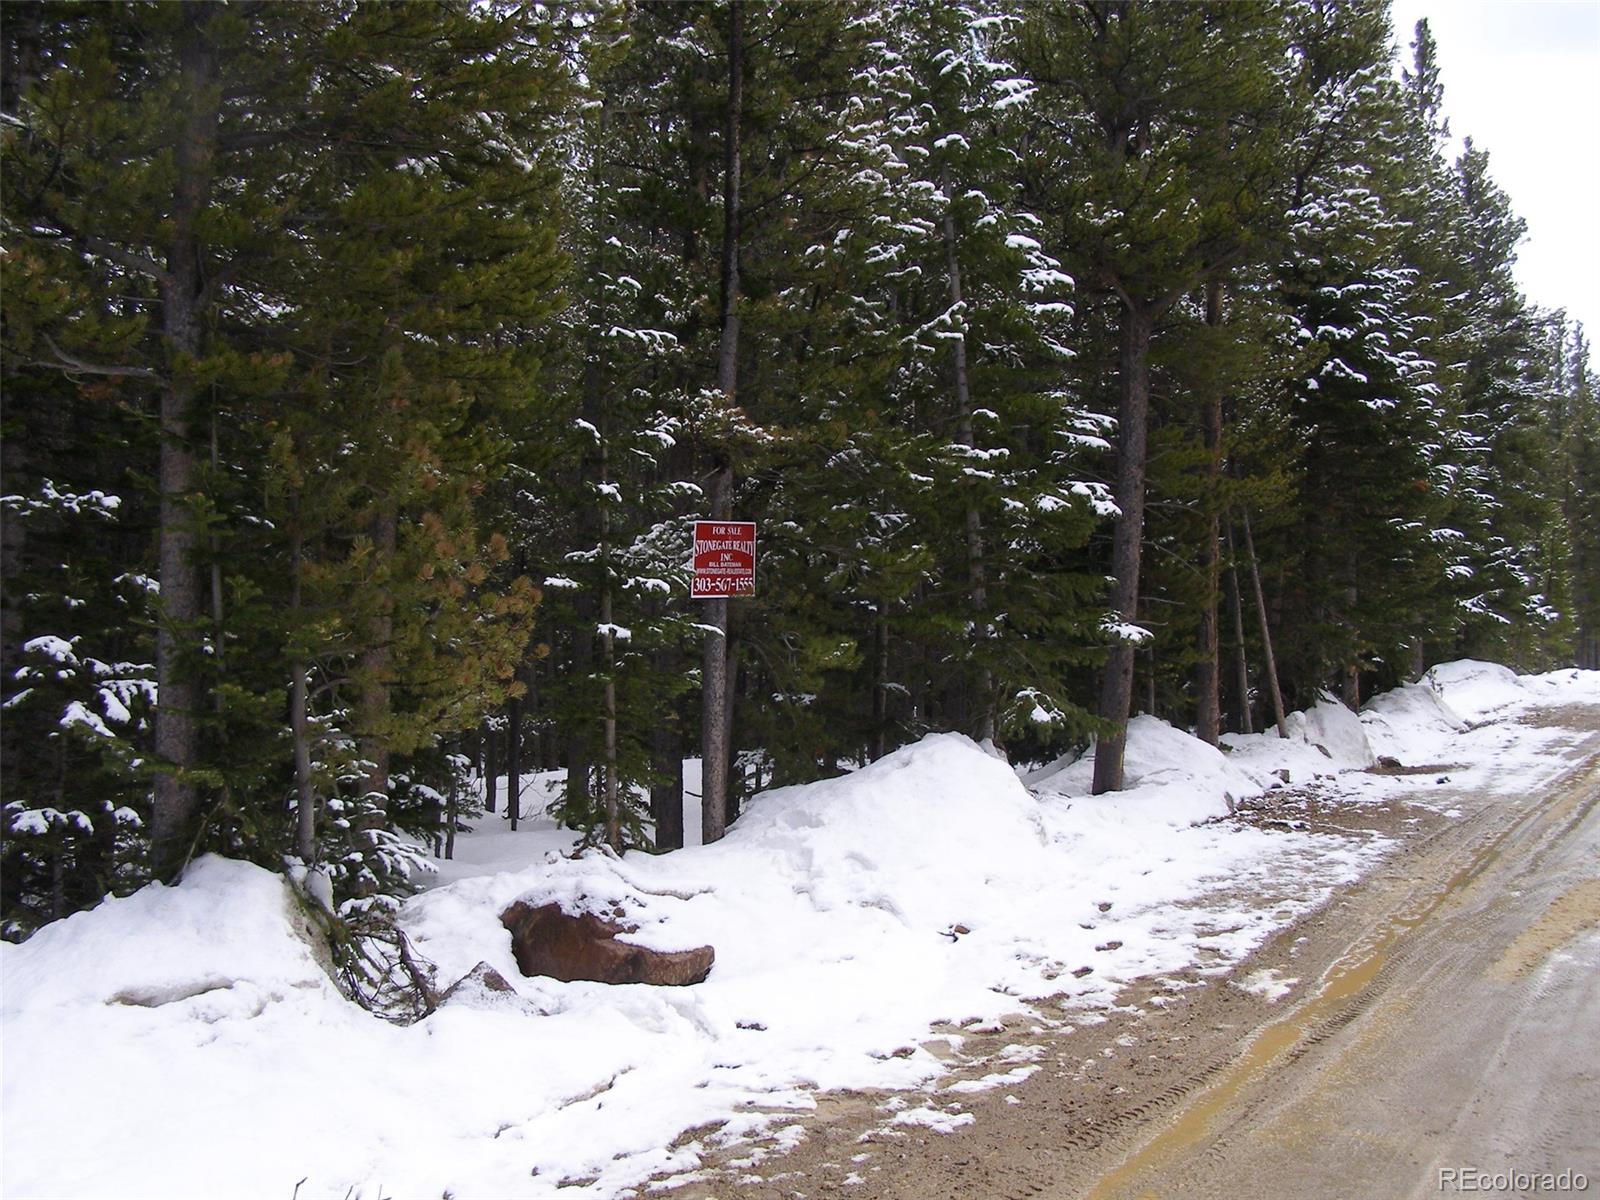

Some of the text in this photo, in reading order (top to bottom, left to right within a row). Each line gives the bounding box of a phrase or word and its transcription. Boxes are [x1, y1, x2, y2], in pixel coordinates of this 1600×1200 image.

[712, 526, 742, 535] FOR SALE
[695, 540, 753, 557] STONEGATE REALTY
[720, 553, 733, 562] INC
[694, 578, 753, 592] 303-567-1555
